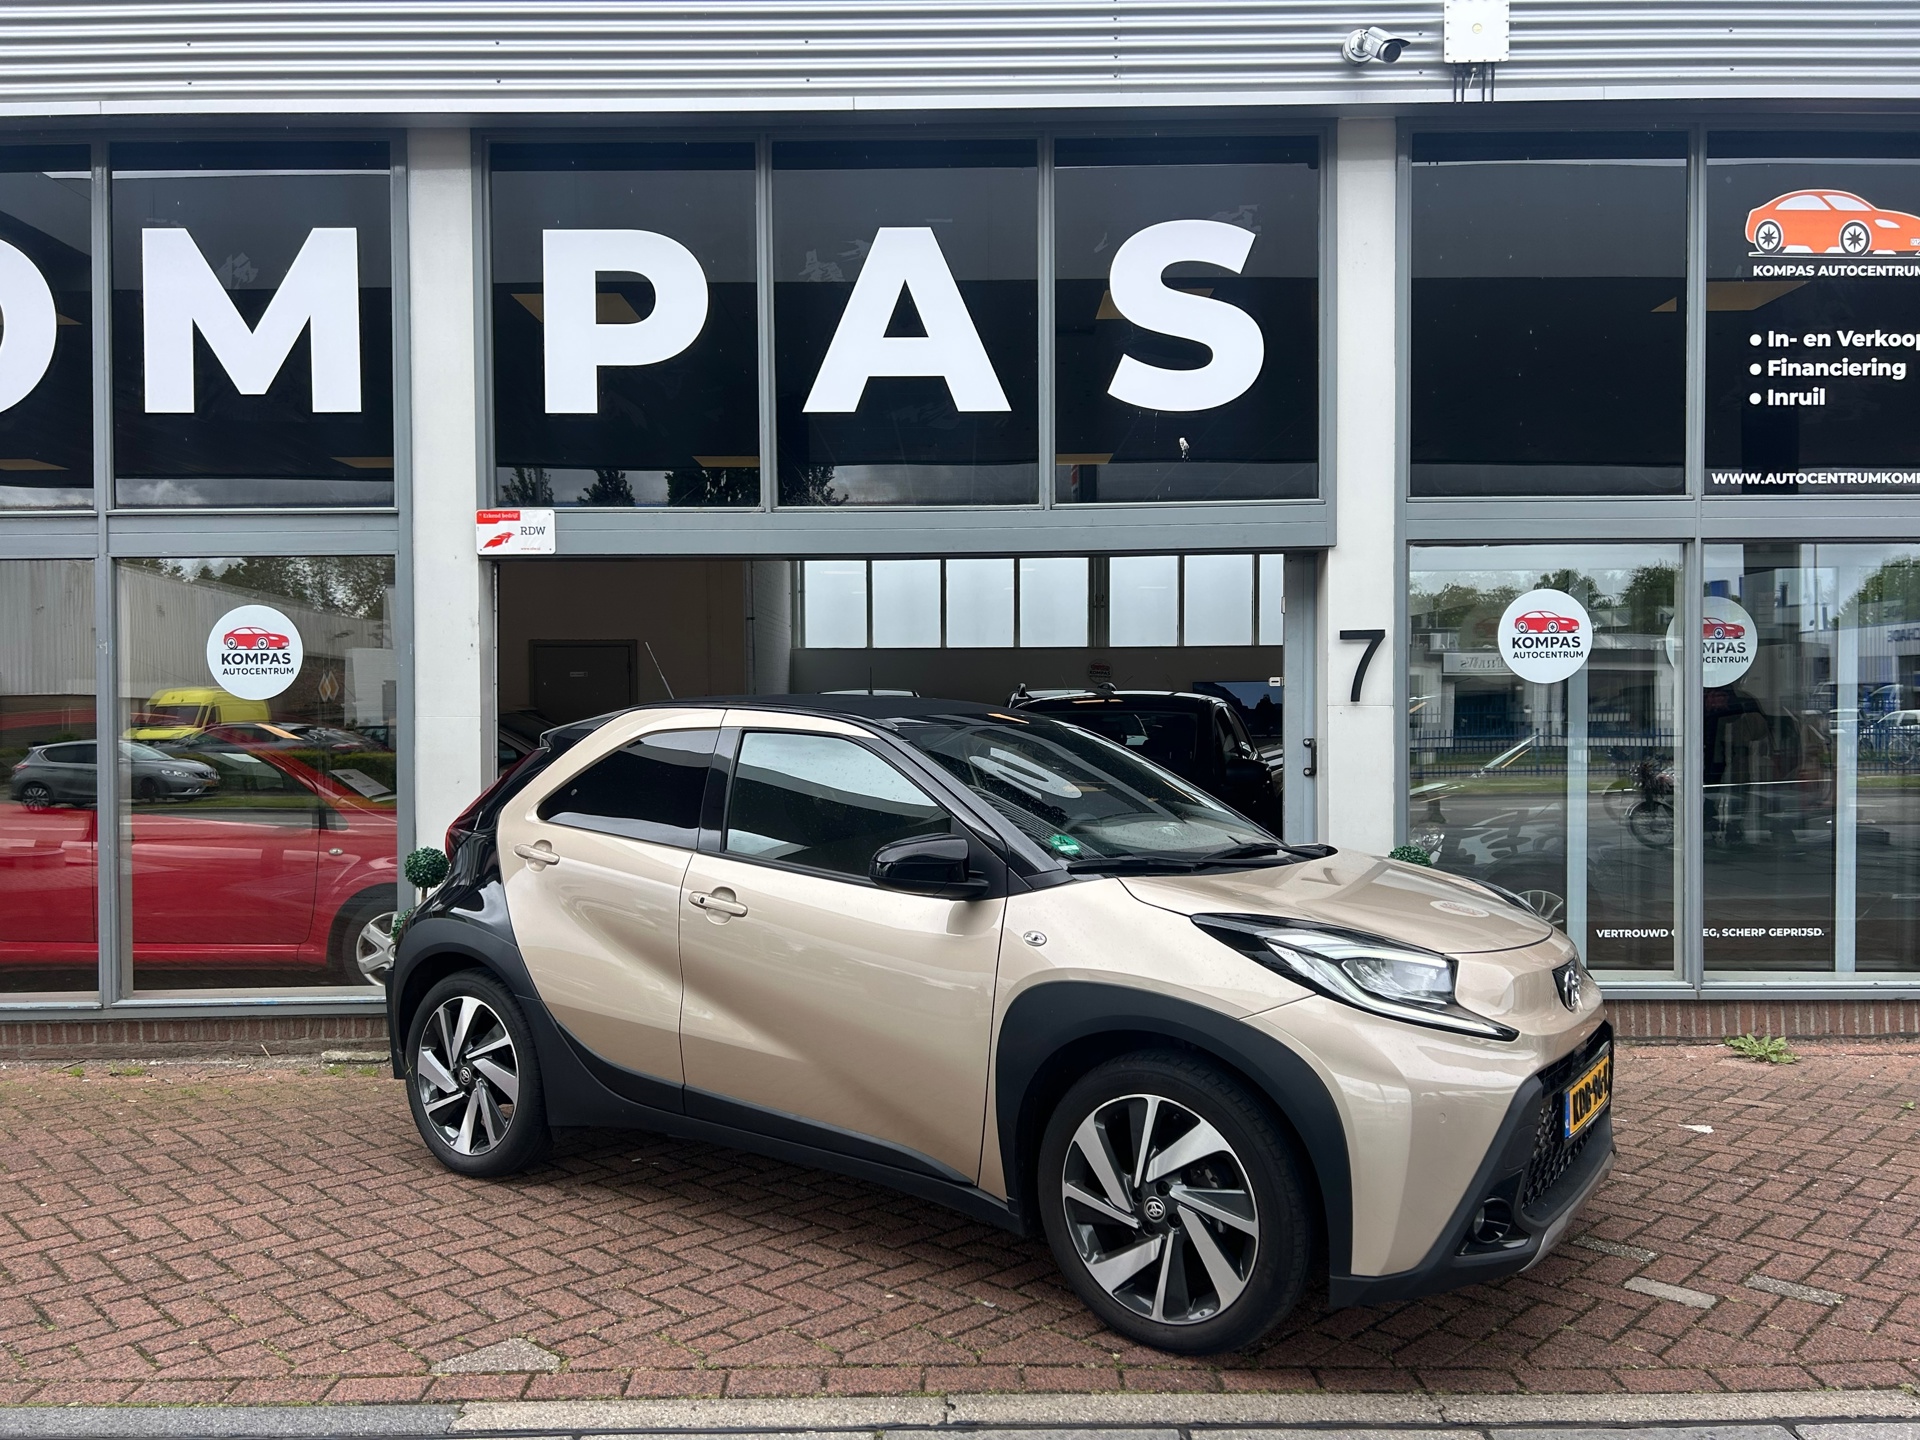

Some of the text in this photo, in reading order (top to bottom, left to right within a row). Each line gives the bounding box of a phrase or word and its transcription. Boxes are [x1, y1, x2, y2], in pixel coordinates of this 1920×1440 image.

[1752, 264, 1815, 277] KOMPAS
[0, 219, 1265, 414] MPAS
[1767, 330, 1798, 348] In-
[1803, 333, 1832, 348] en
[1767, 357, 1907, 380] Financiering
[1767, 386, 1826, 406] Inruil
[520, 526, 546, 536] RDW
[1511, 636, 1581, 649] KOMPAS
[1703, 641, 1747, 654] MPAS
[221, 652, 291, 666] KOMPAS
[1513, 650, 1584, 659] AUTOCENTRUM
[1702, 656, 1749, 664] CENTRUM
[222, 667, 295, 676] AUTOCENTRUM
[1339, 629, 1386, 703] 7
[1596, 928, 1669, 938] VERTROUWD
[1703, 928, 1719, 939] EG,
[1721, 928, 1767, 938] SCHERP
[1768, 927, 1825, 937] GEPRIJSD.
